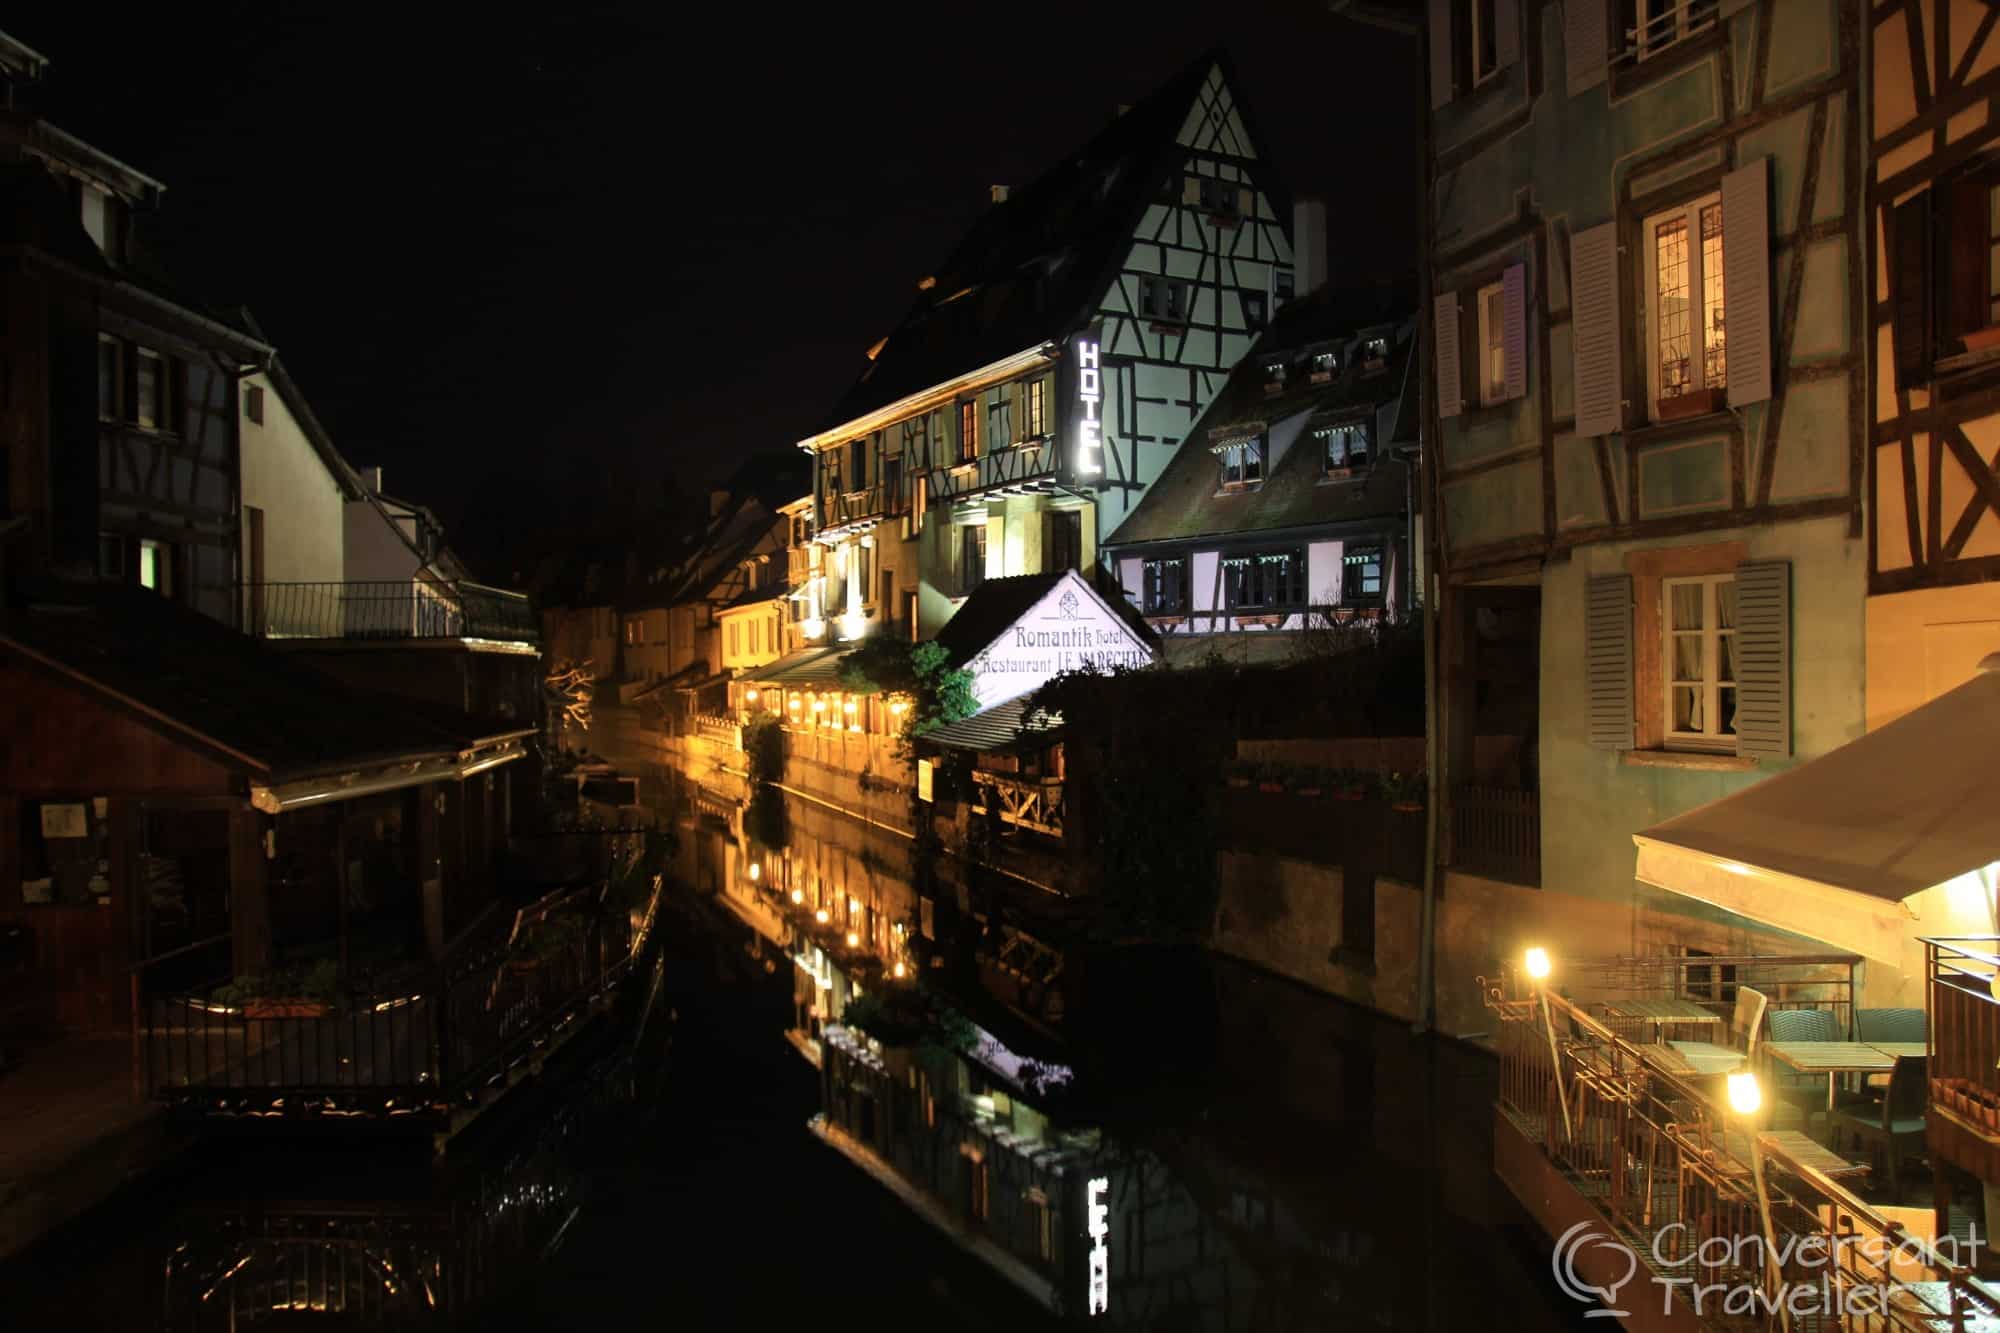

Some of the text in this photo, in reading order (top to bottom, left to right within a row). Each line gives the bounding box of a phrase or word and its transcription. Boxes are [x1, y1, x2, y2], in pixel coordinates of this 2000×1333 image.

[1079, 341, 1102, 474] HOTEL
[1016, 626, 1092, 648] Romantik
[983, 658, 1051, 674] Restaurant
